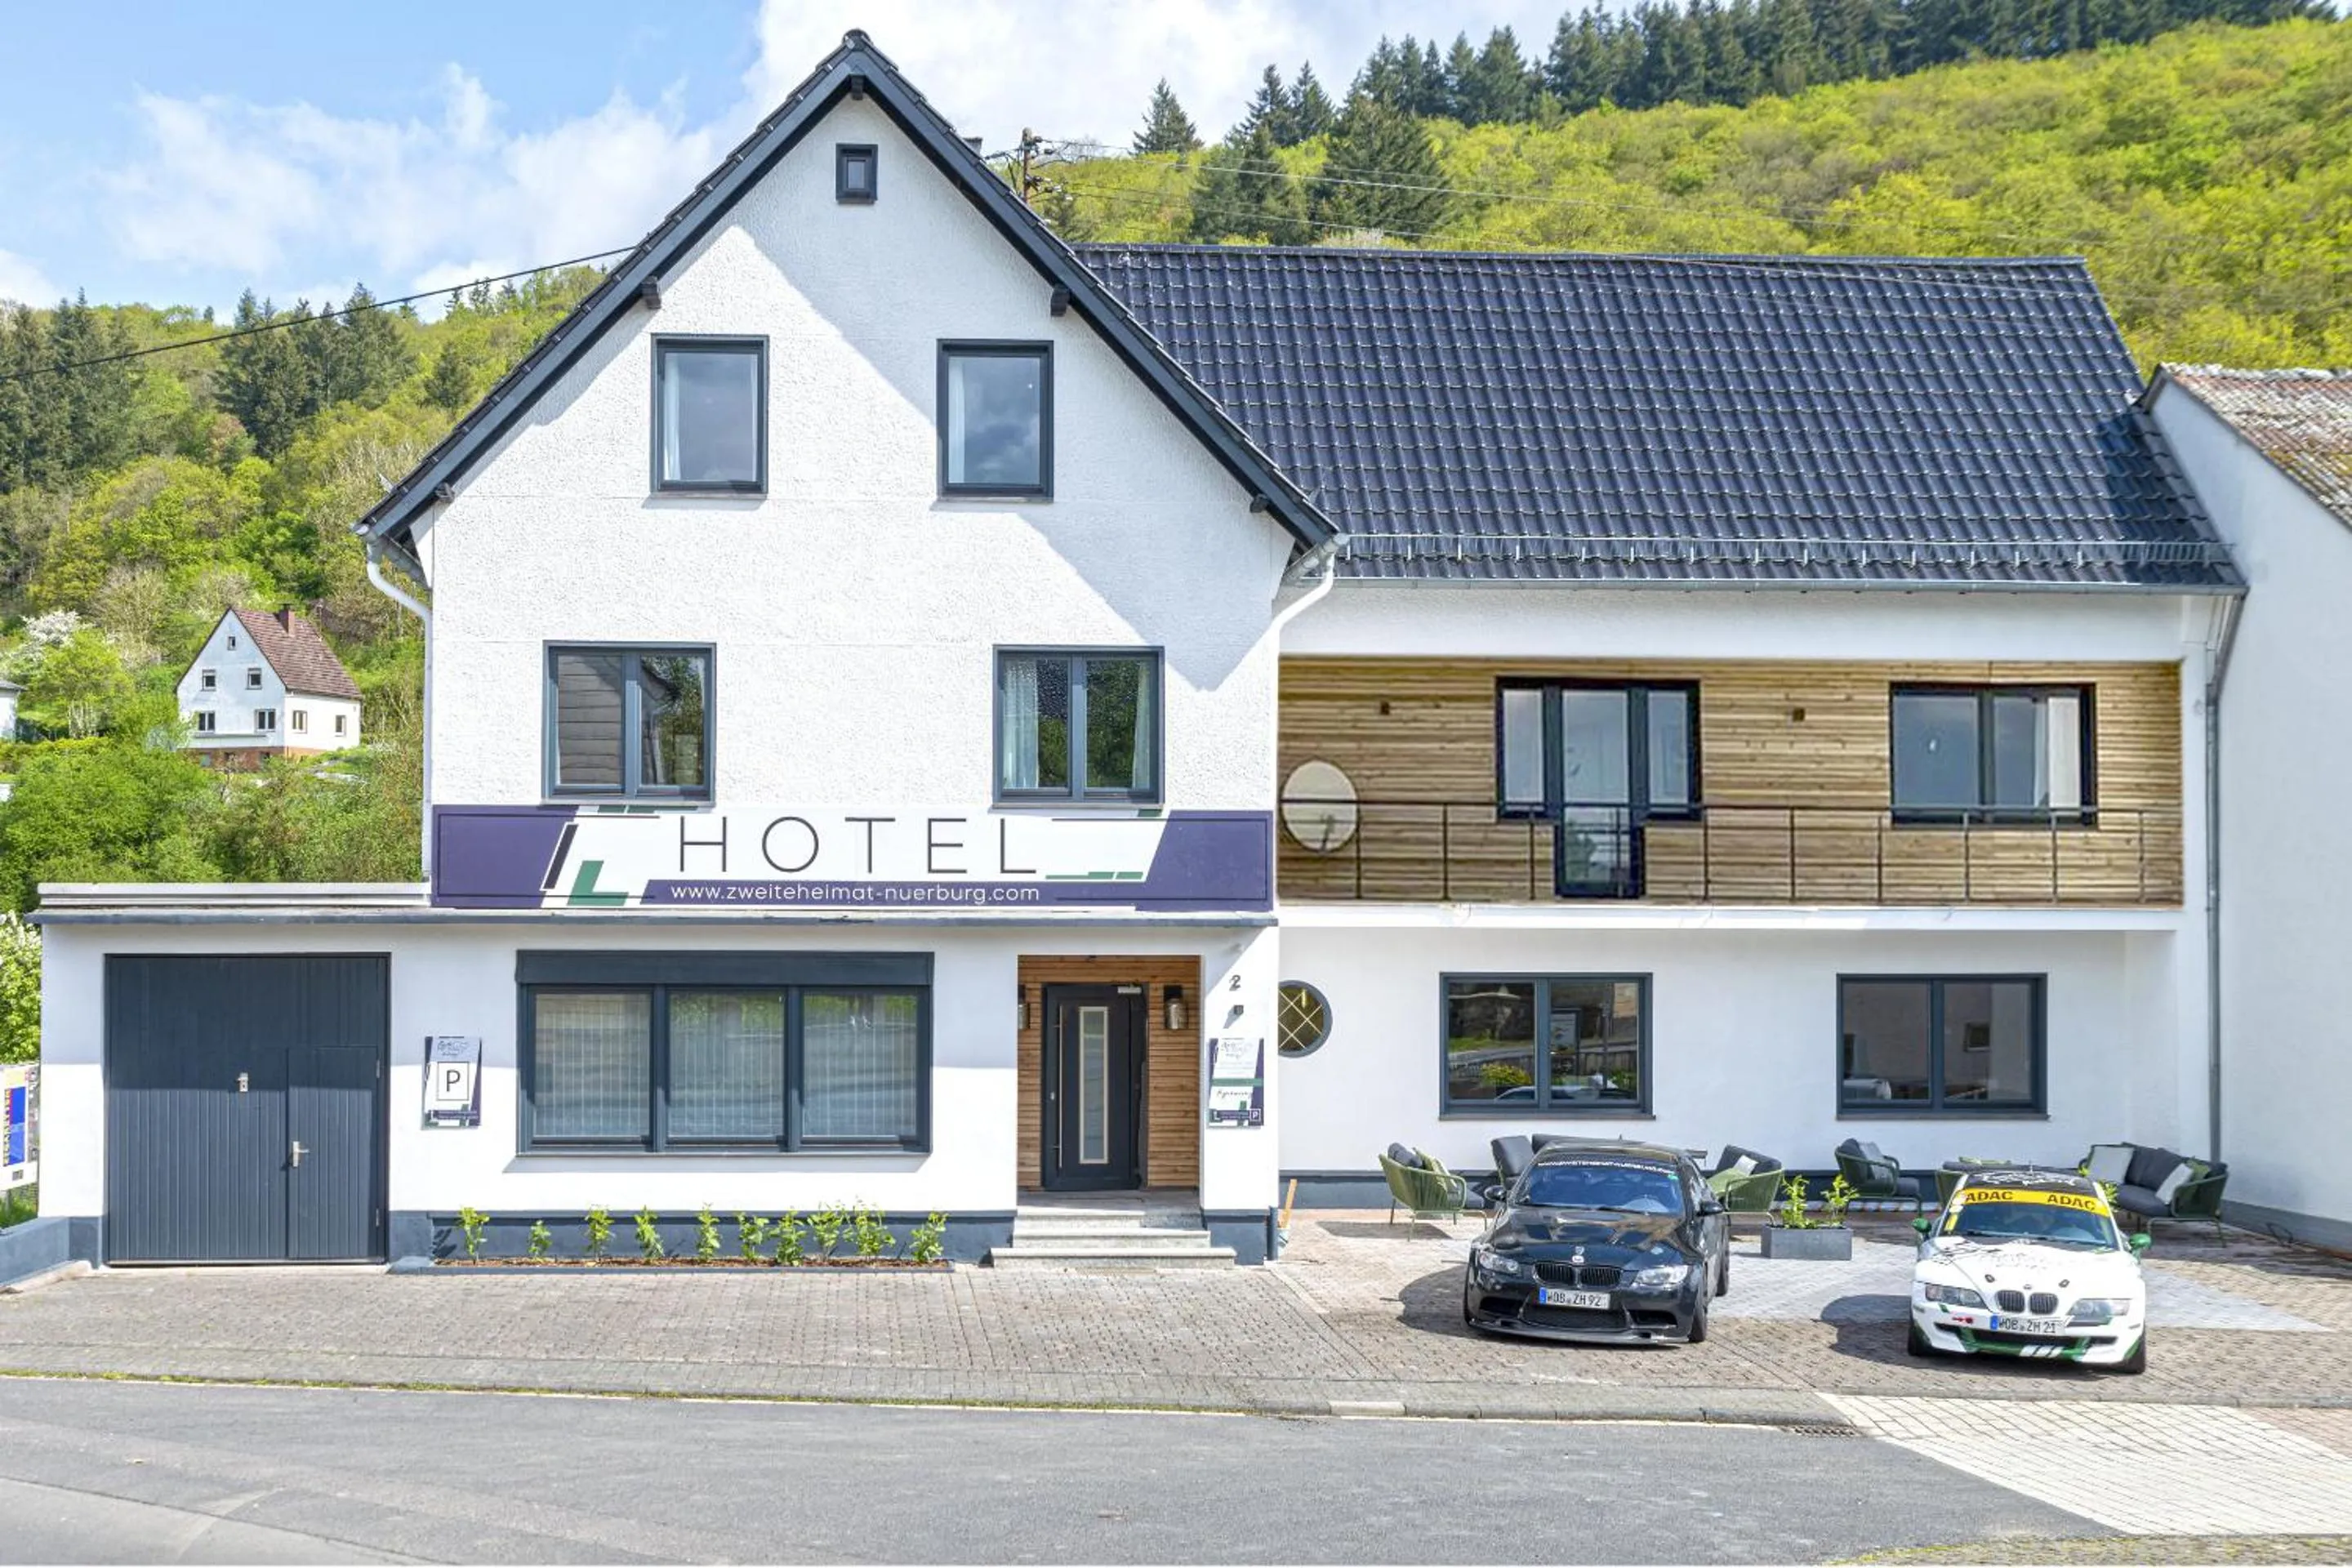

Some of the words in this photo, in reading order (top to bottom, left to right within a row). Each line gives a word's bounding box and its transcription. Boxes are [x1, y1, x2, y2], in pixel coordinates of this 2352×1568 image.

[679, 815, 1036, 874] HOTEL
[670, 883, 1040, 904] www.zweiteheimat-nuerburg.com
[1230, 974, 1241, 991] 2
[446, 1069, 461, 1093] P
[1965, 1191, 2014, 1202] ADAC
[2047, 1194, 2096, 1212] ADAC
